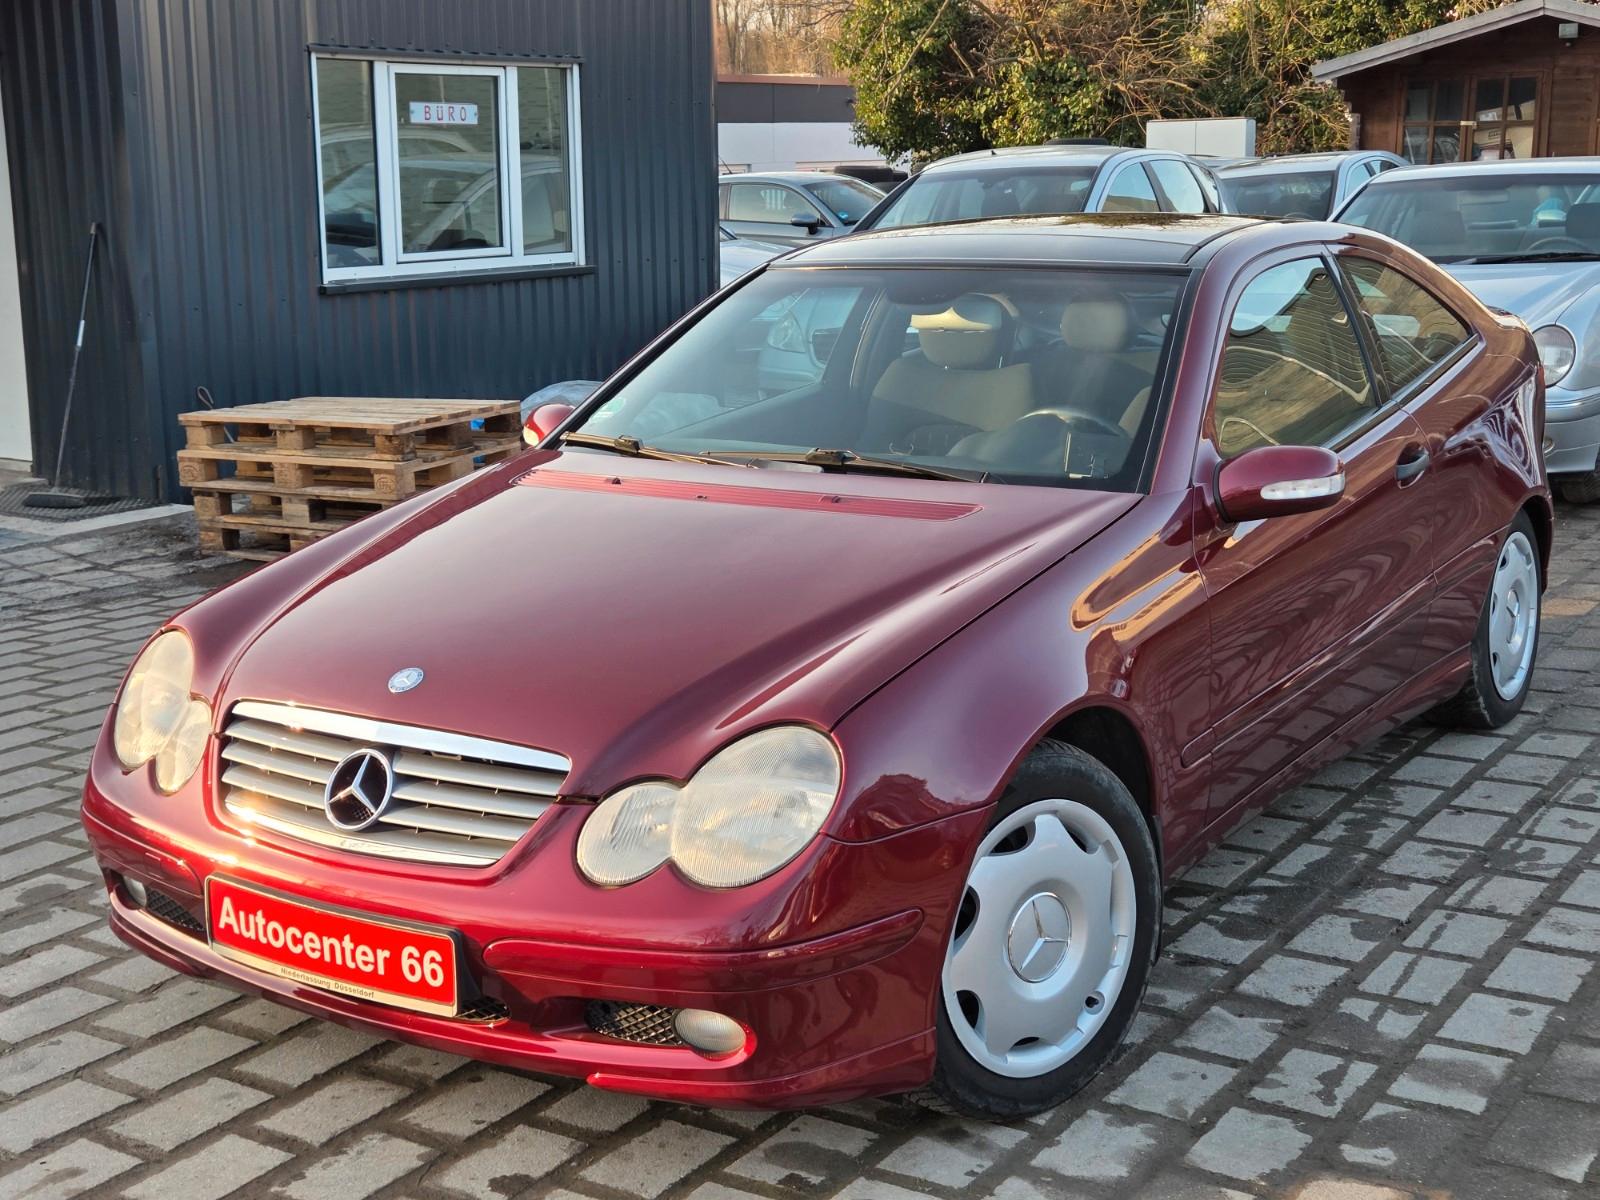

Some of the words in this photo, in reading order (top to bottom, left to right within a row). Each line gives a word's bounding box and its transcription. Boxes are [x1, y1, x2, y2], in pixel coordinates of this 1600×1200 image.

[218, 896, 391, 976] Autocenter
[401, 945, 445, 987] 66
[281, 967, 331, 989] Niederlassung
[334, 981, 375, 999] Düsseldorf
